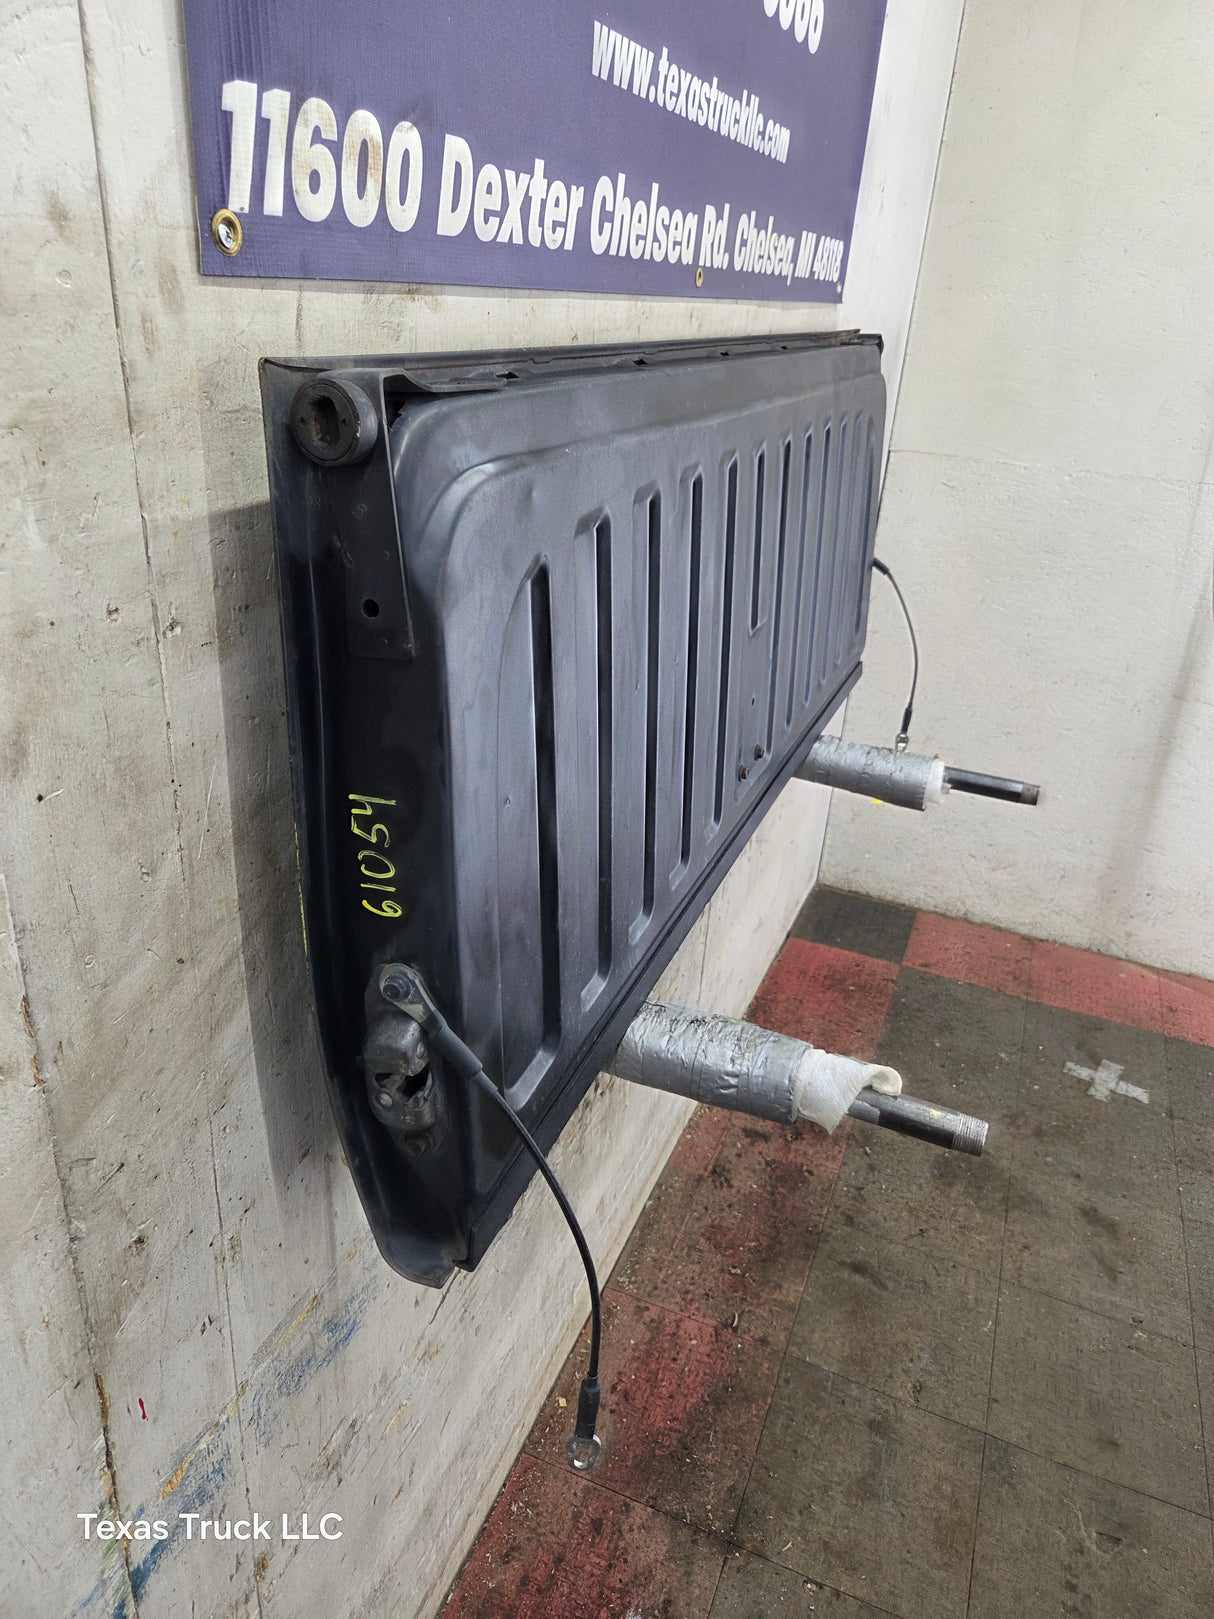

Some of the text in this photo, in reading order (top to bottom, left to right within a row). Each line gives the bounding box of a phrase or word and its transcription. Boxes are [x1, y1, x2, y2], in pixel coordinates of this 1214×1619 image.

[592, 20, 790, 164] www.texastruckllc.com
[221, 79, 844, 286] 11600 Dexter Chelsea Rd. Chelsea, MI 48118
[348, 793, 403, 918] 61054
